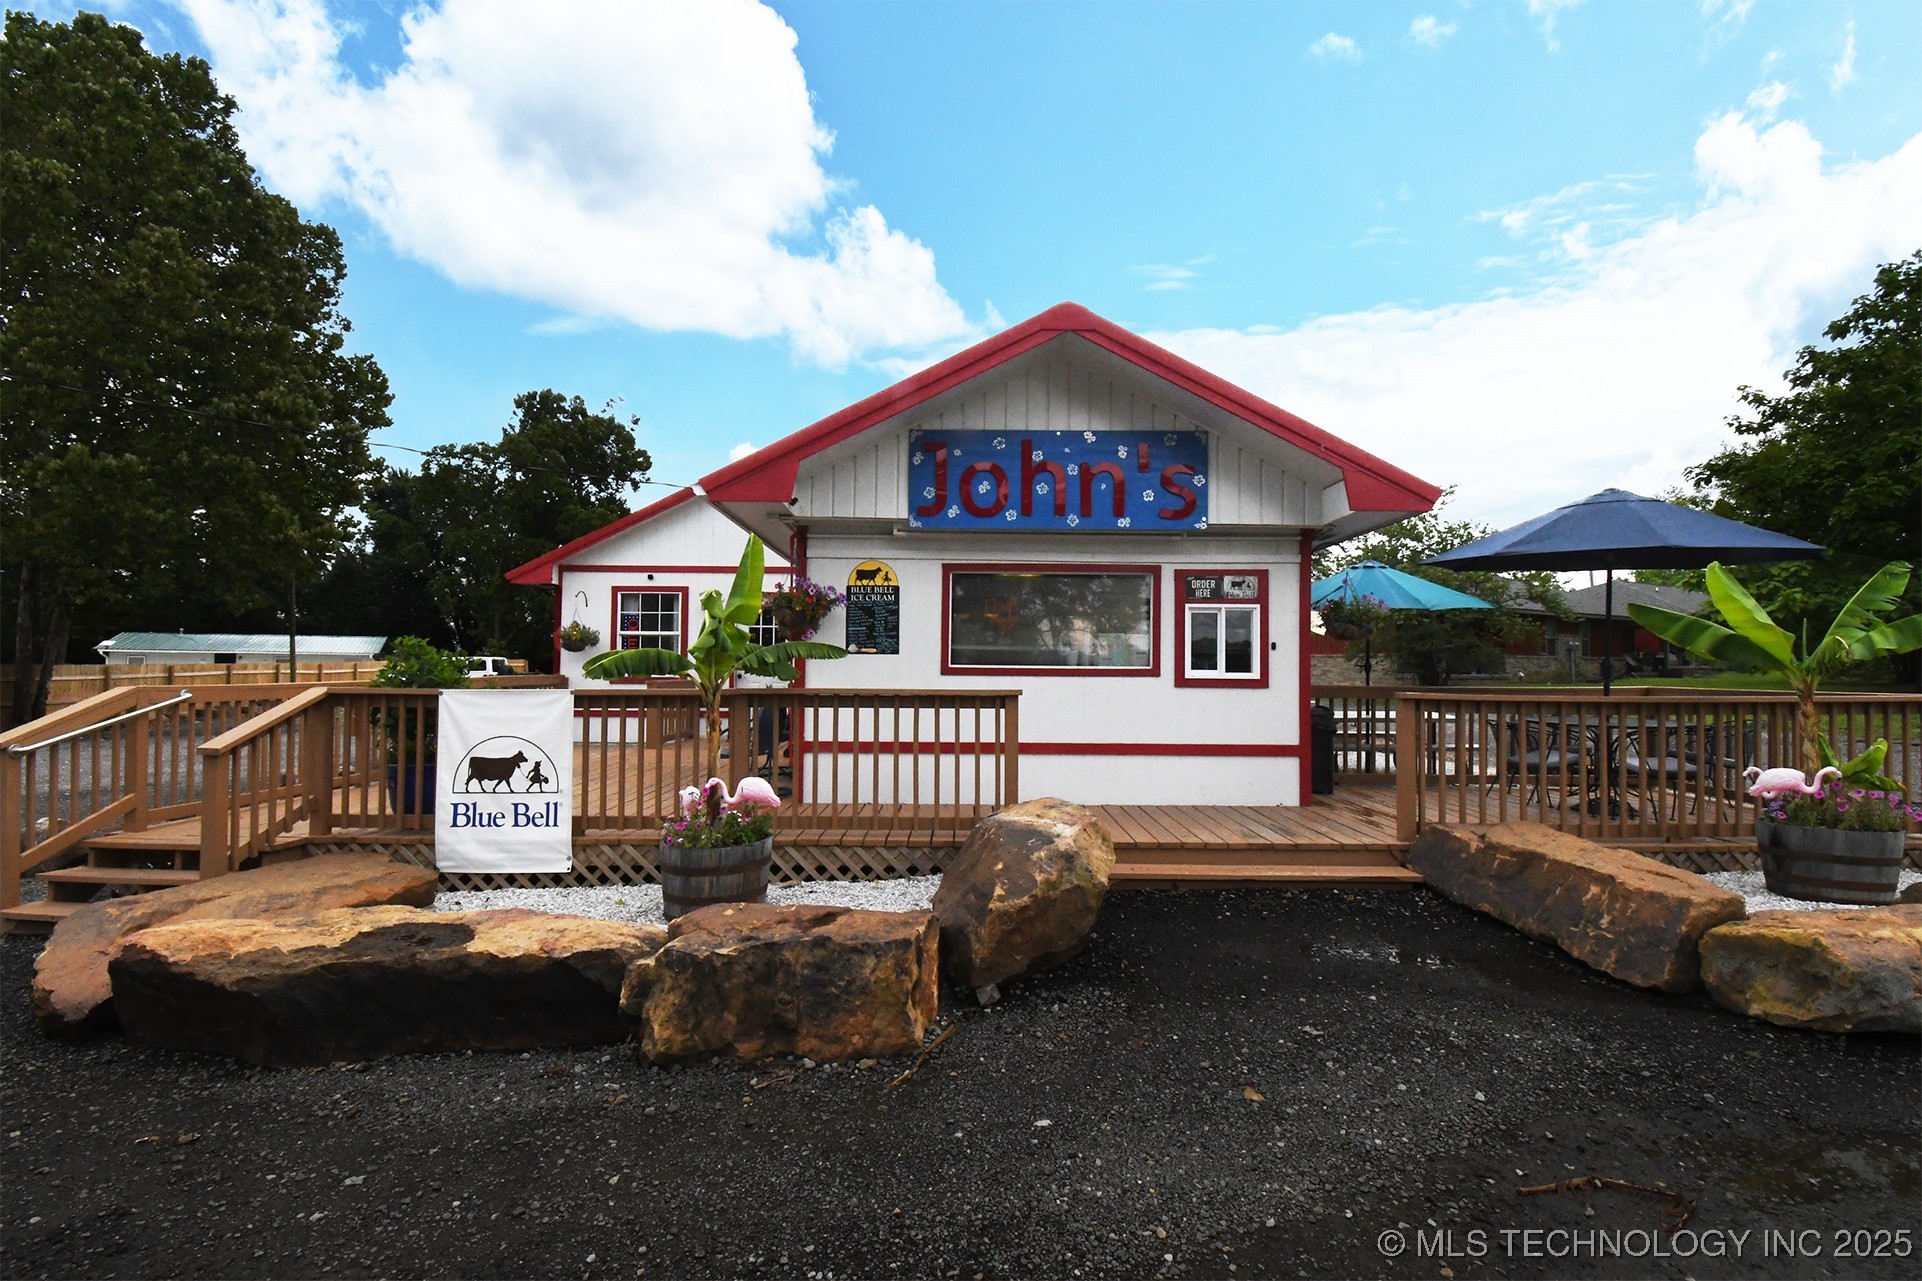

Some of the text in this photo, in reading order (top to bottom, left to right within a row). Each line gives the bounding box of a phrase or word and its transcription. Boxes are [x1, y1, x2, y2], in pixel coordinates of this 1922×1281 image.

[917, 439, 1198, 519] John's
[1191, 580, 1216, 589] ORDER
[1195, 589, 1211, 598] HERE
[450, 801, 559, 828] Blue Bell
